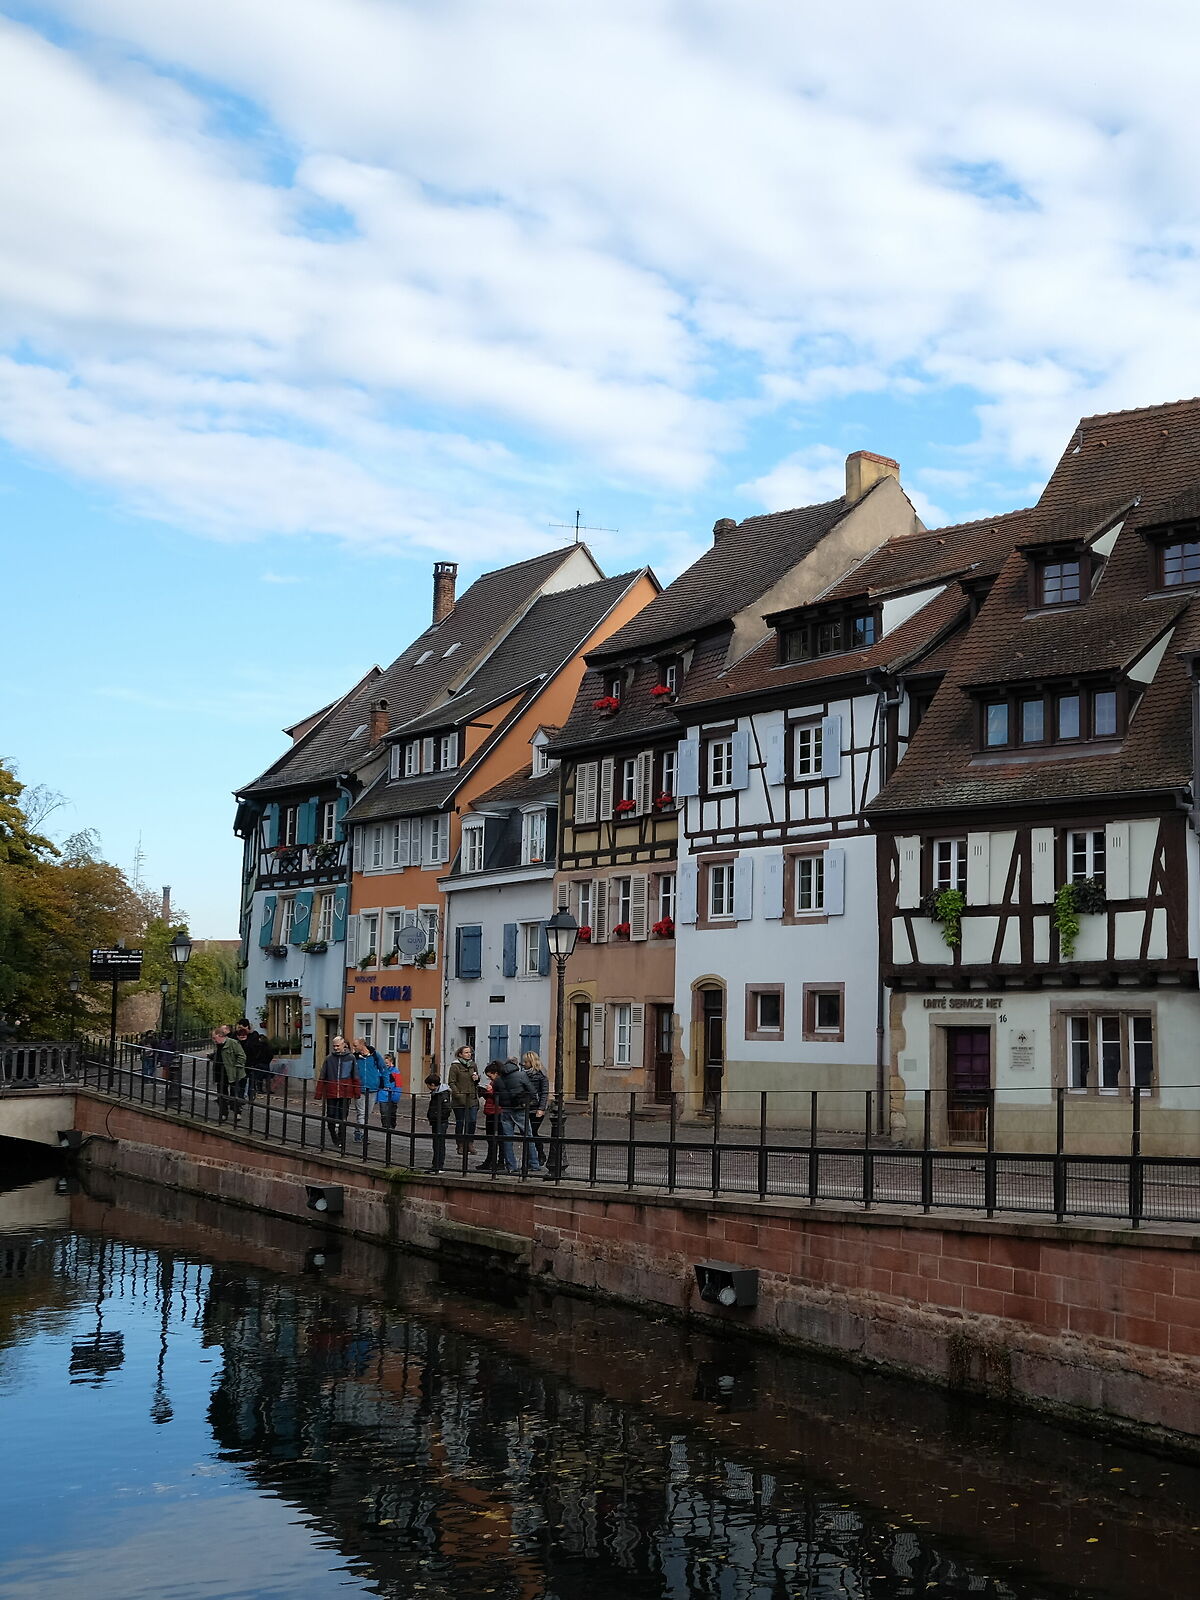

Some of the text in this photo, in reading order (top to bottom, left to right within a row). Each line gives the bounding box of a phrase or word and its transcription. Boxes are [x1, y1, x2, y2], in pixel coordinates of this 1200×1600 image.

[923, 996, 1003, 1009] UNITÉ SERVICE NET
[998, 1014, 1008, 1023] 16
